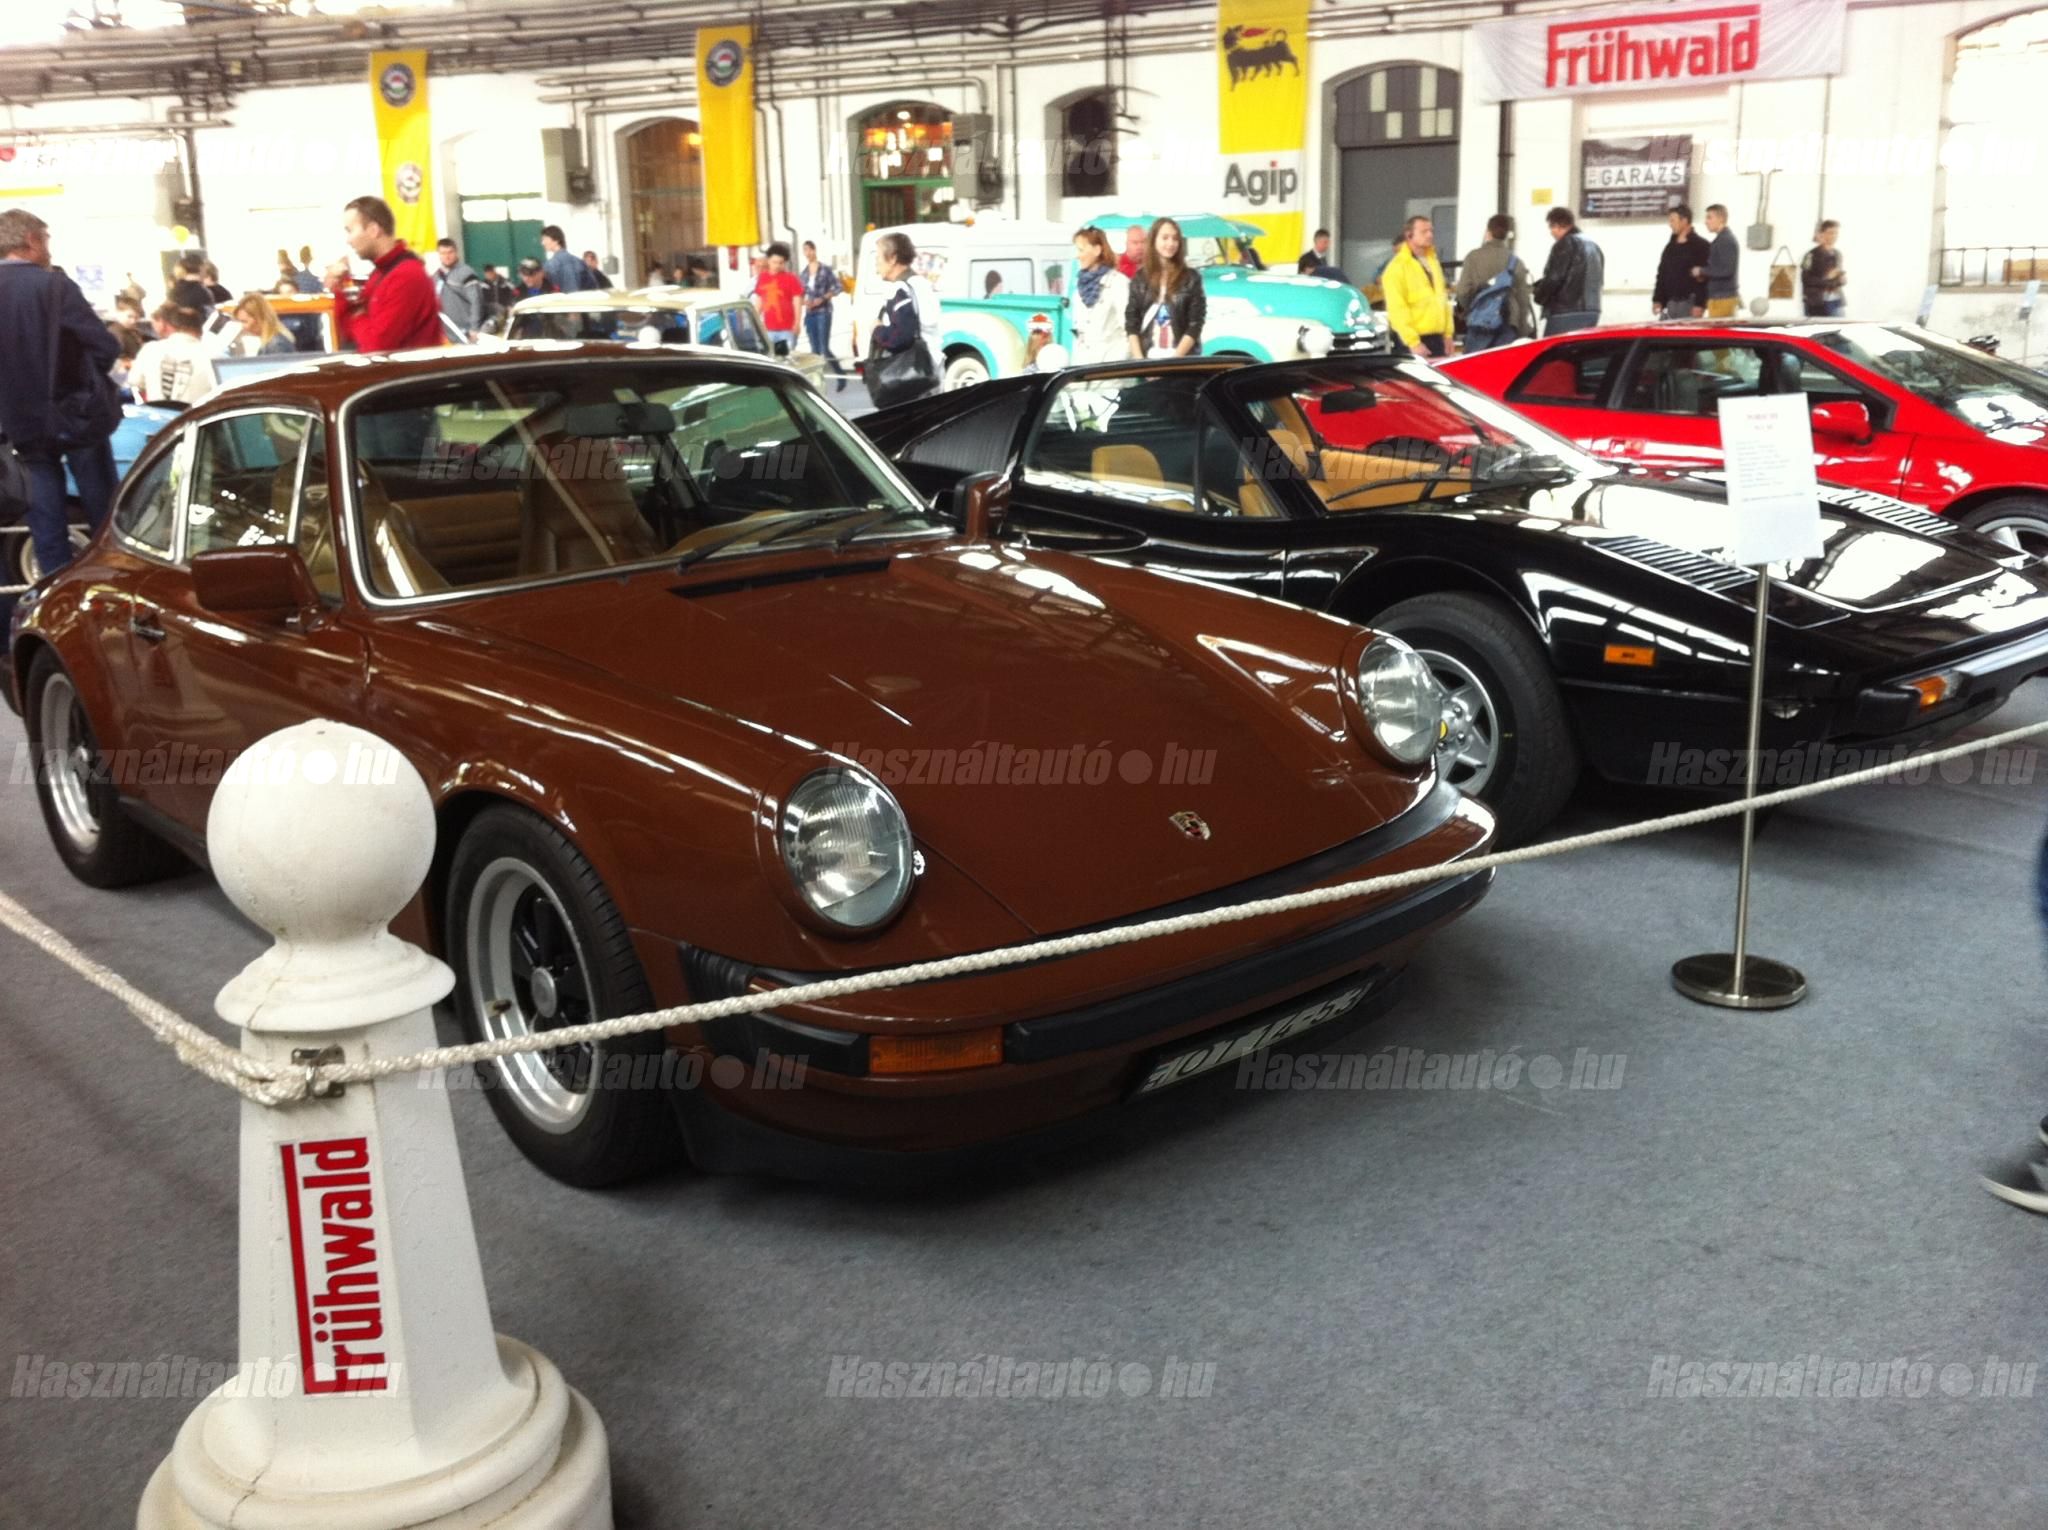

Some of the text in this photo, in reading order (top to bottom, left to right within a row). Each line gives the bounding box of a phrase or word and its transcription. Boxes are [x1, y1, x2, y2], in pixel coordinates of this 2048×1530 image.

[1545, 4, 1761, 88] Frühwald
[1222, 160, 1298, 206] Agip
[280, 1137, 388, 1395] Frühwald
